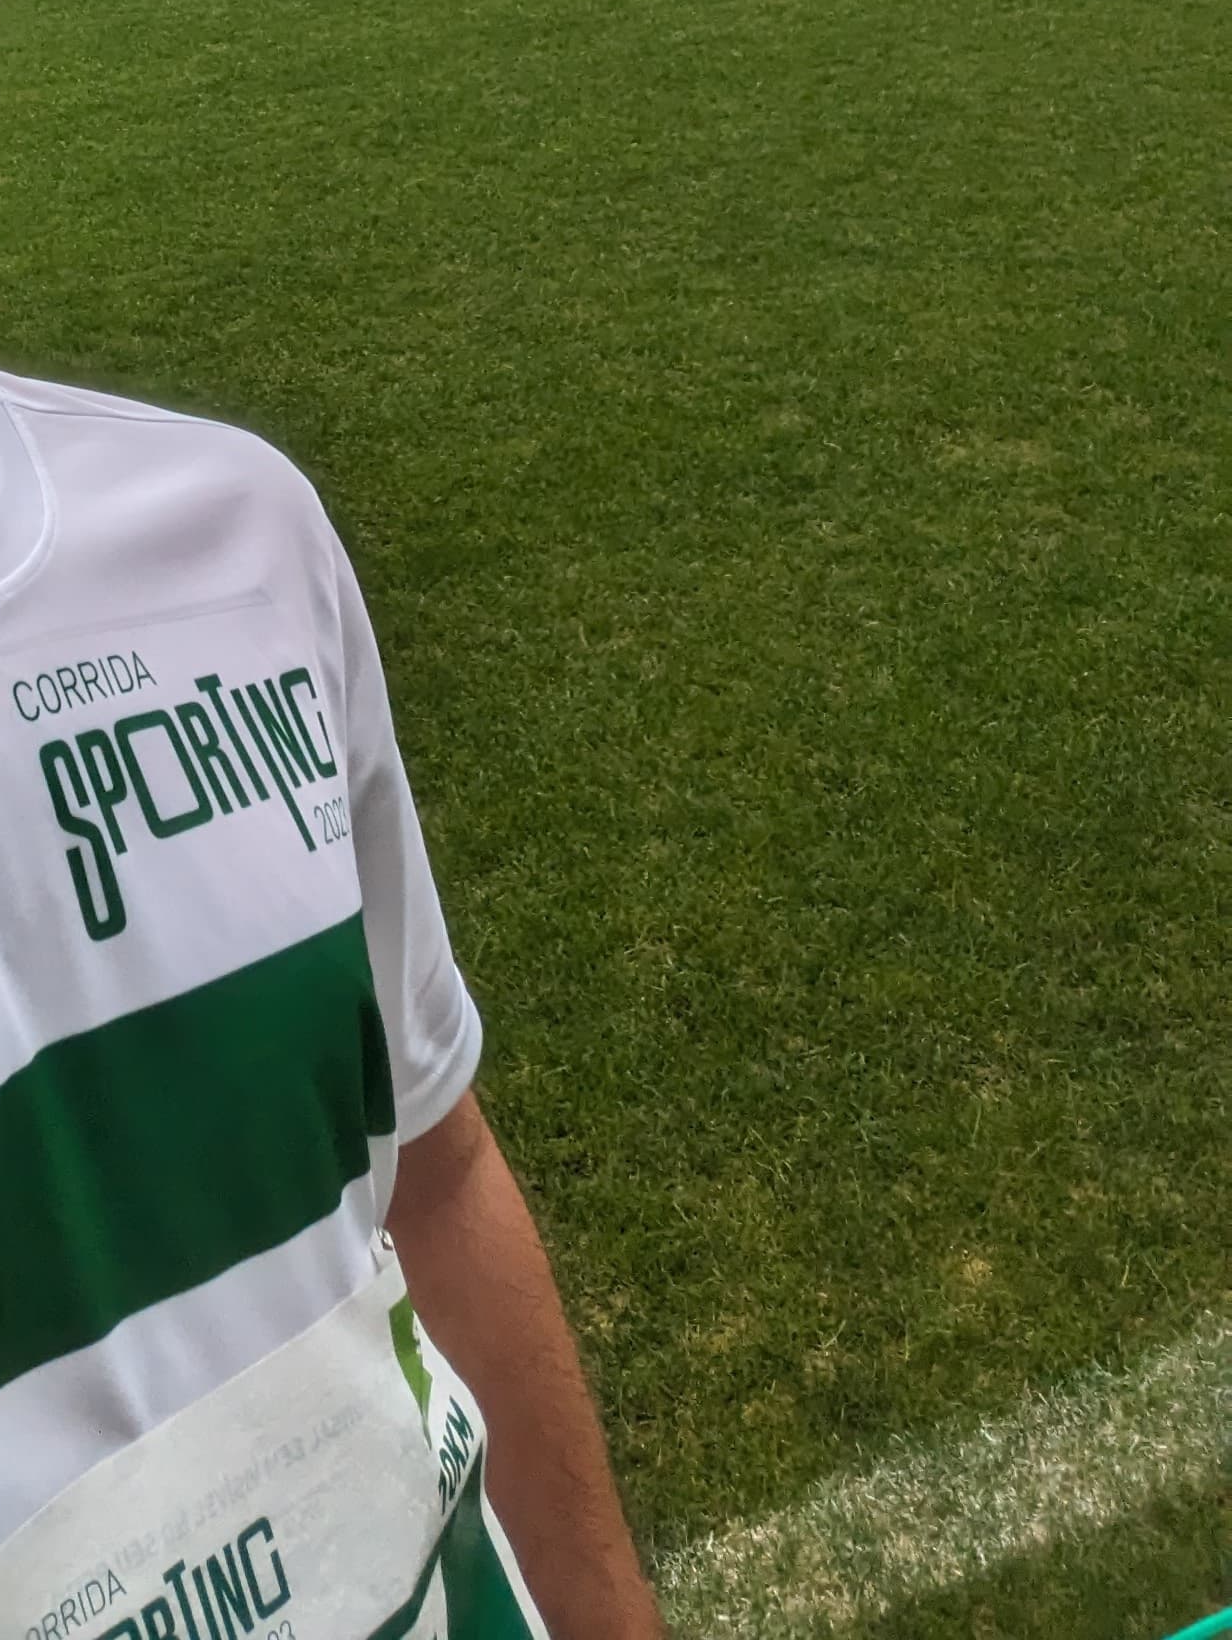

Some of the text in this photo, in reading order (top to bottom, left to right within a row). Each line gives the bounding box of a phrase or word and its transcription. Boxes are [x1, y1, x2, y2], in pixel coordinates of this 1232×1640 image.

[12, 650, 158, 722] CORRIDA
[38, 666, 339, 943] SPORTING
[92, 1516, 292, 1640] RTING
